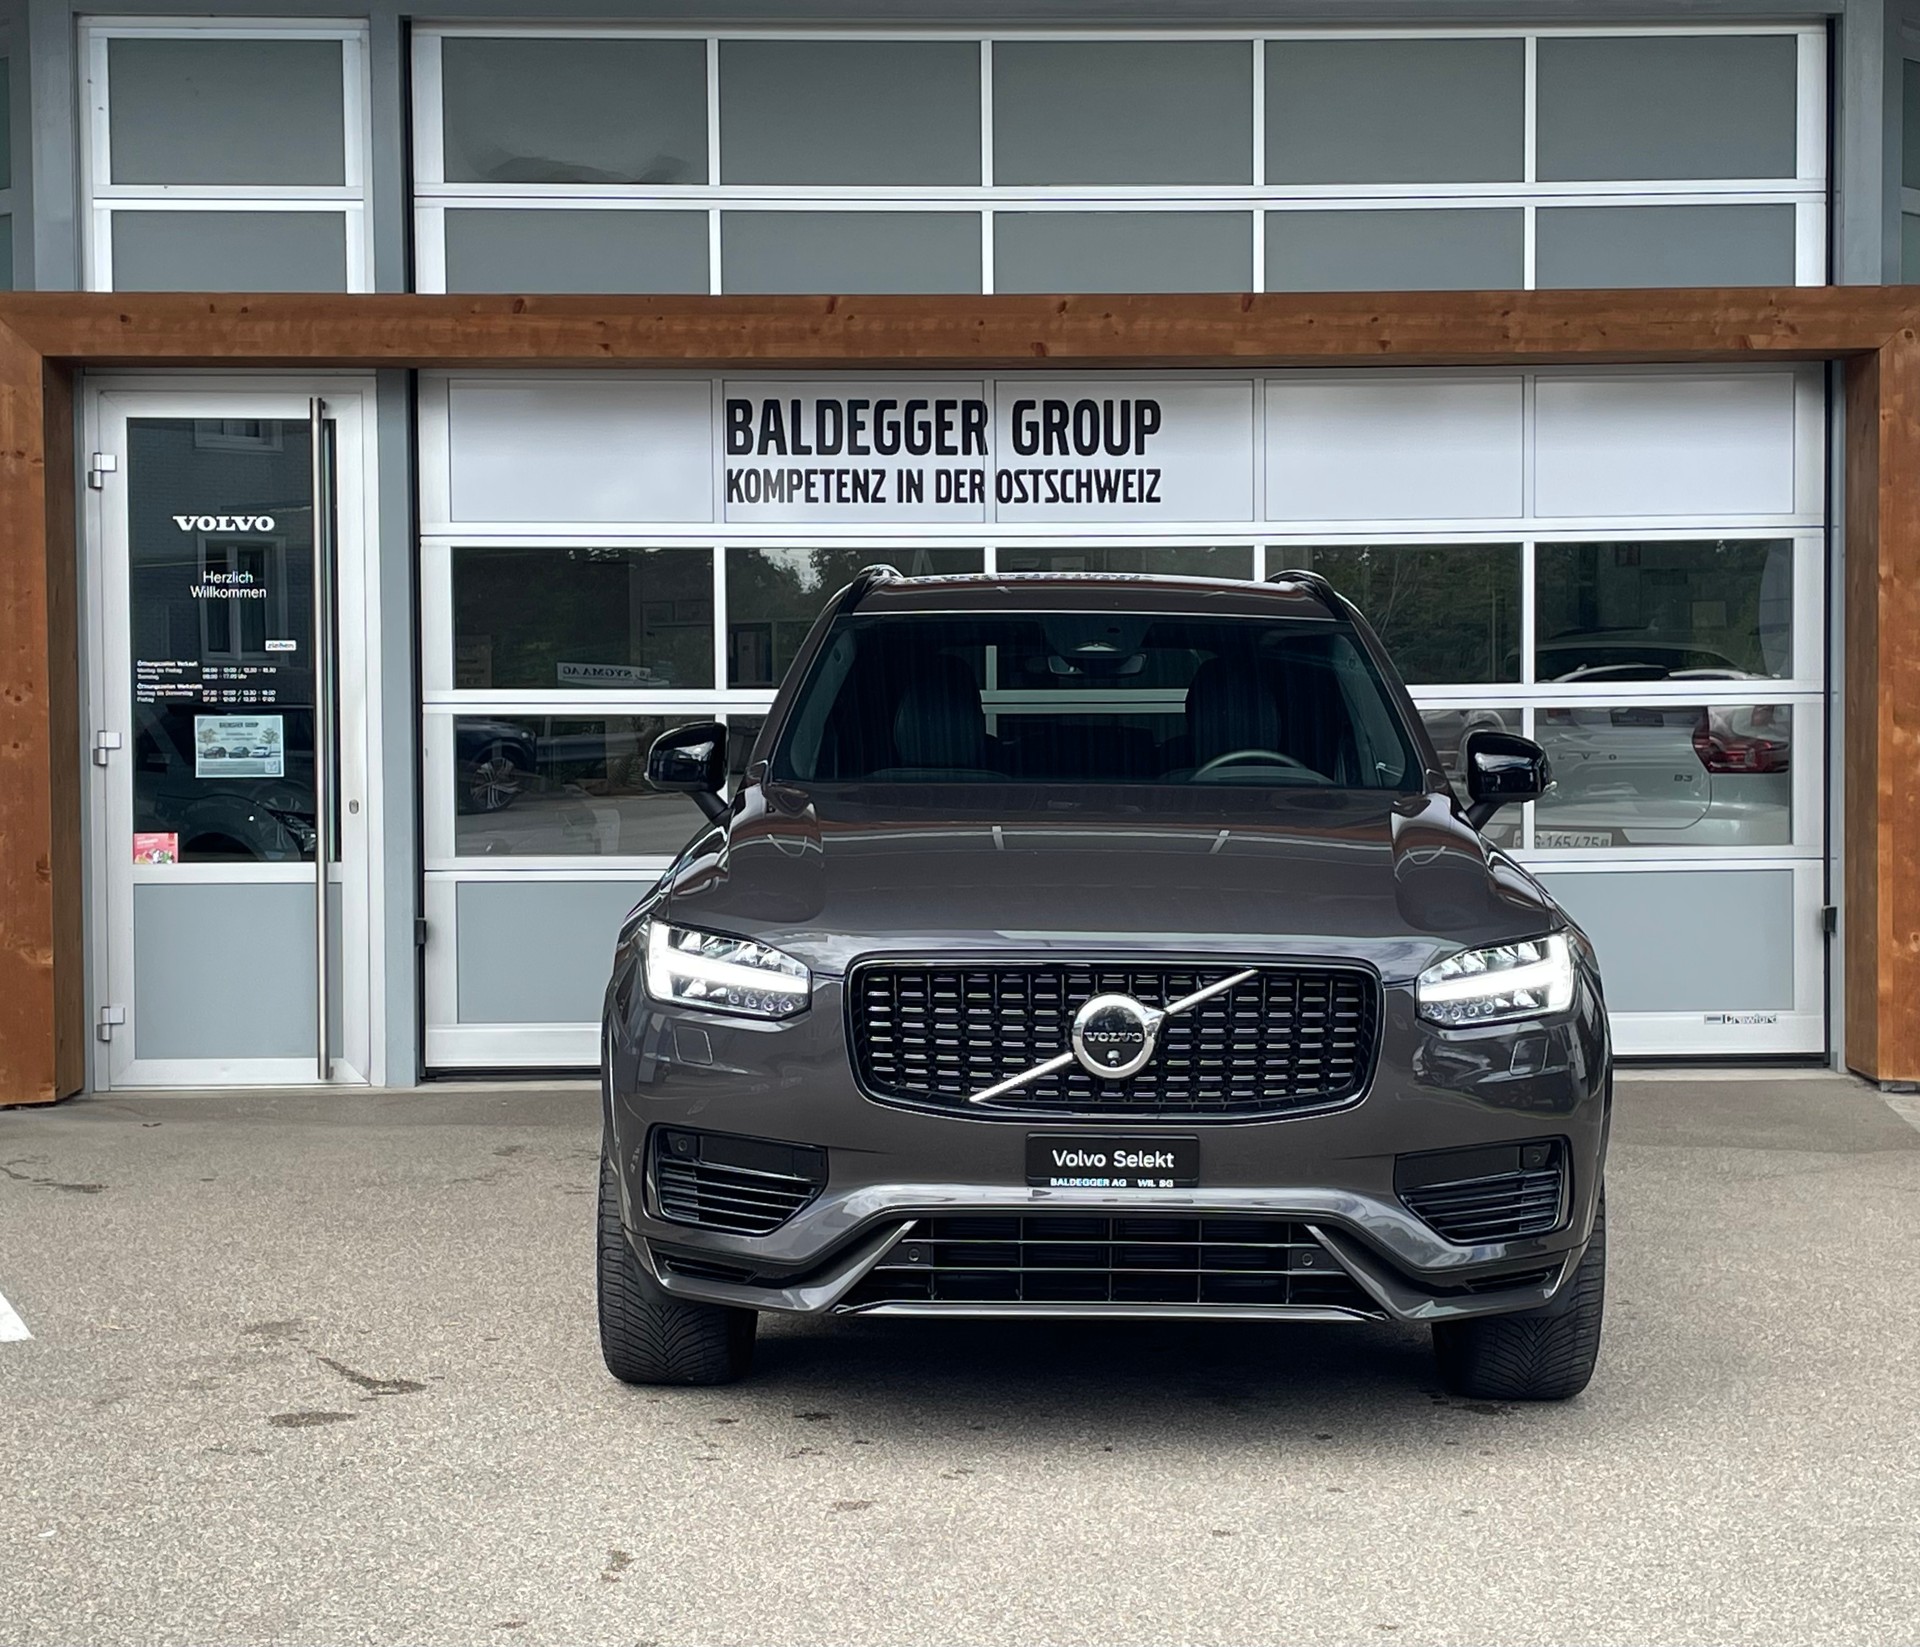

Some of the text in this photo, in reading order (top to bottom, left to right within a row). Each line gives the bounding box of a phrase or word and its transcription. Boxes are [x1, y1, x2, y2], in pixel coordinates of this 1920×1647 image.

[726, 399, 1161, 455] BALDEGGER GROUP
[727, 468, 1161, 503] KOMPETENZ IN DER OSTSCHWEIZ
[172, 515, 275, 531] VOLVO
[203, 570, 254, 583] Herzlich
[190, 585, 267, 598] Willkommen
[1084, 1032, 1143, 1042] VOLVO
[1052, 1149, 1175, 1168] Volvo Selekt
[1050, 1178, 1110, 1187] BALDEGGER
[1111, 1178, 1127, 1187] AG
